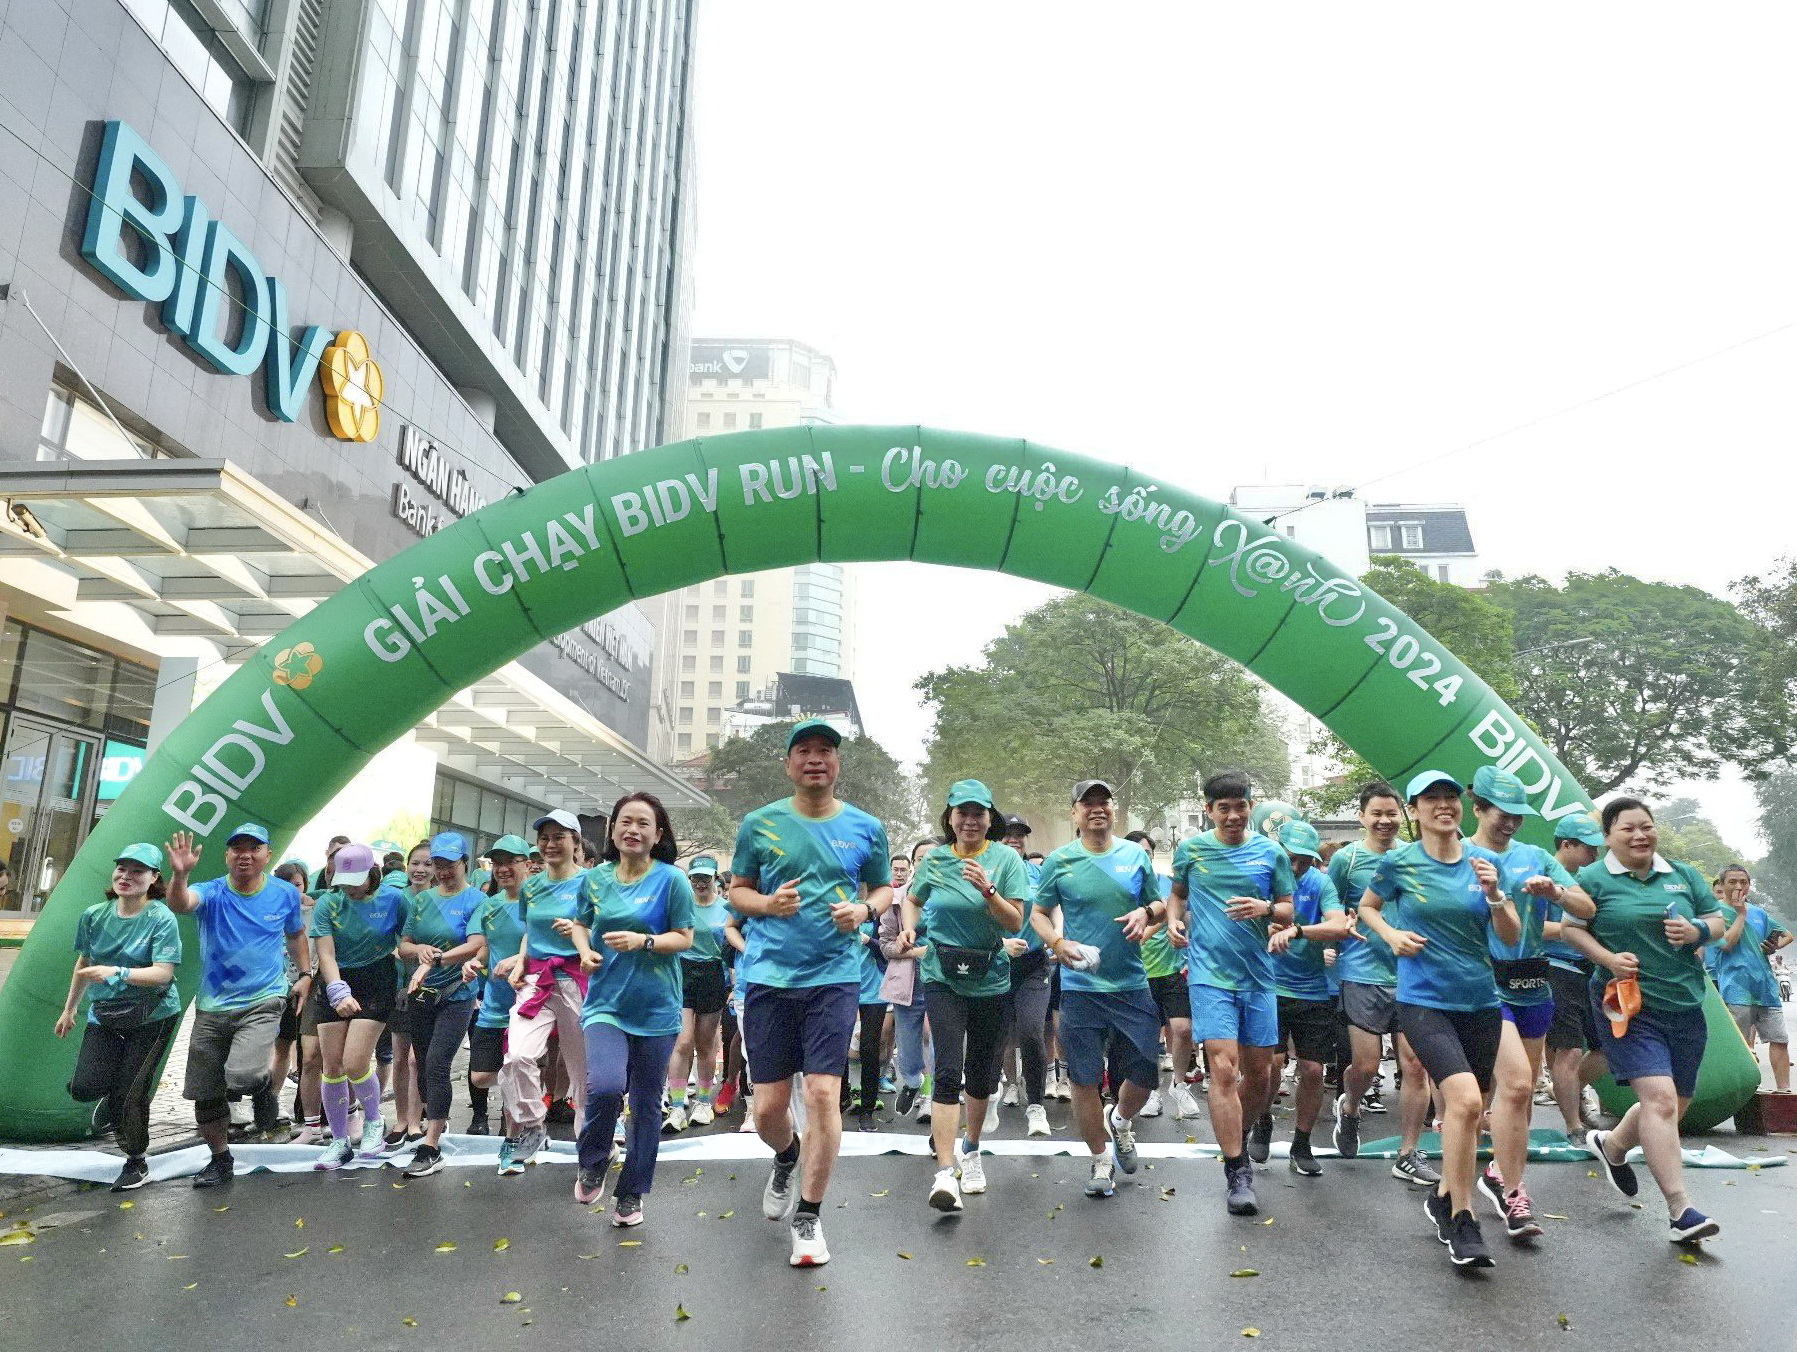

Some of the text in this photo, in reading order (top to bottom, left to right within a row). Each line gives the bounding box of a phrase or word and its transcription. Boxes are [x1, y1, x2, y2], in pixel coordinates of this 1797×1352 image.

[82, 120, 334, 423] BIDV
[398, 483, 436, 537] Bank
[403, 425, 450, 500] NGÂN
[363, 574, 472, 663] GIẢI
[473, 503, 601, 596] CHẠY
[610, 467, 718, 538] BIDV
[738, 451, 838, 506] RUN
[881, 446, 969, 492] Cho
[984, 461, 1084, 512] cuộc
[1098, 484, 1203, 553] sống
[1209, 519, 1366, 627] X@nh
[1363, 616, 1464, 708] 2024
[161, 687, 295, 838] BIDV
[1468, 709, 1588, 822] BIDV
[1509, 977, 1547, 989] SPORTS
